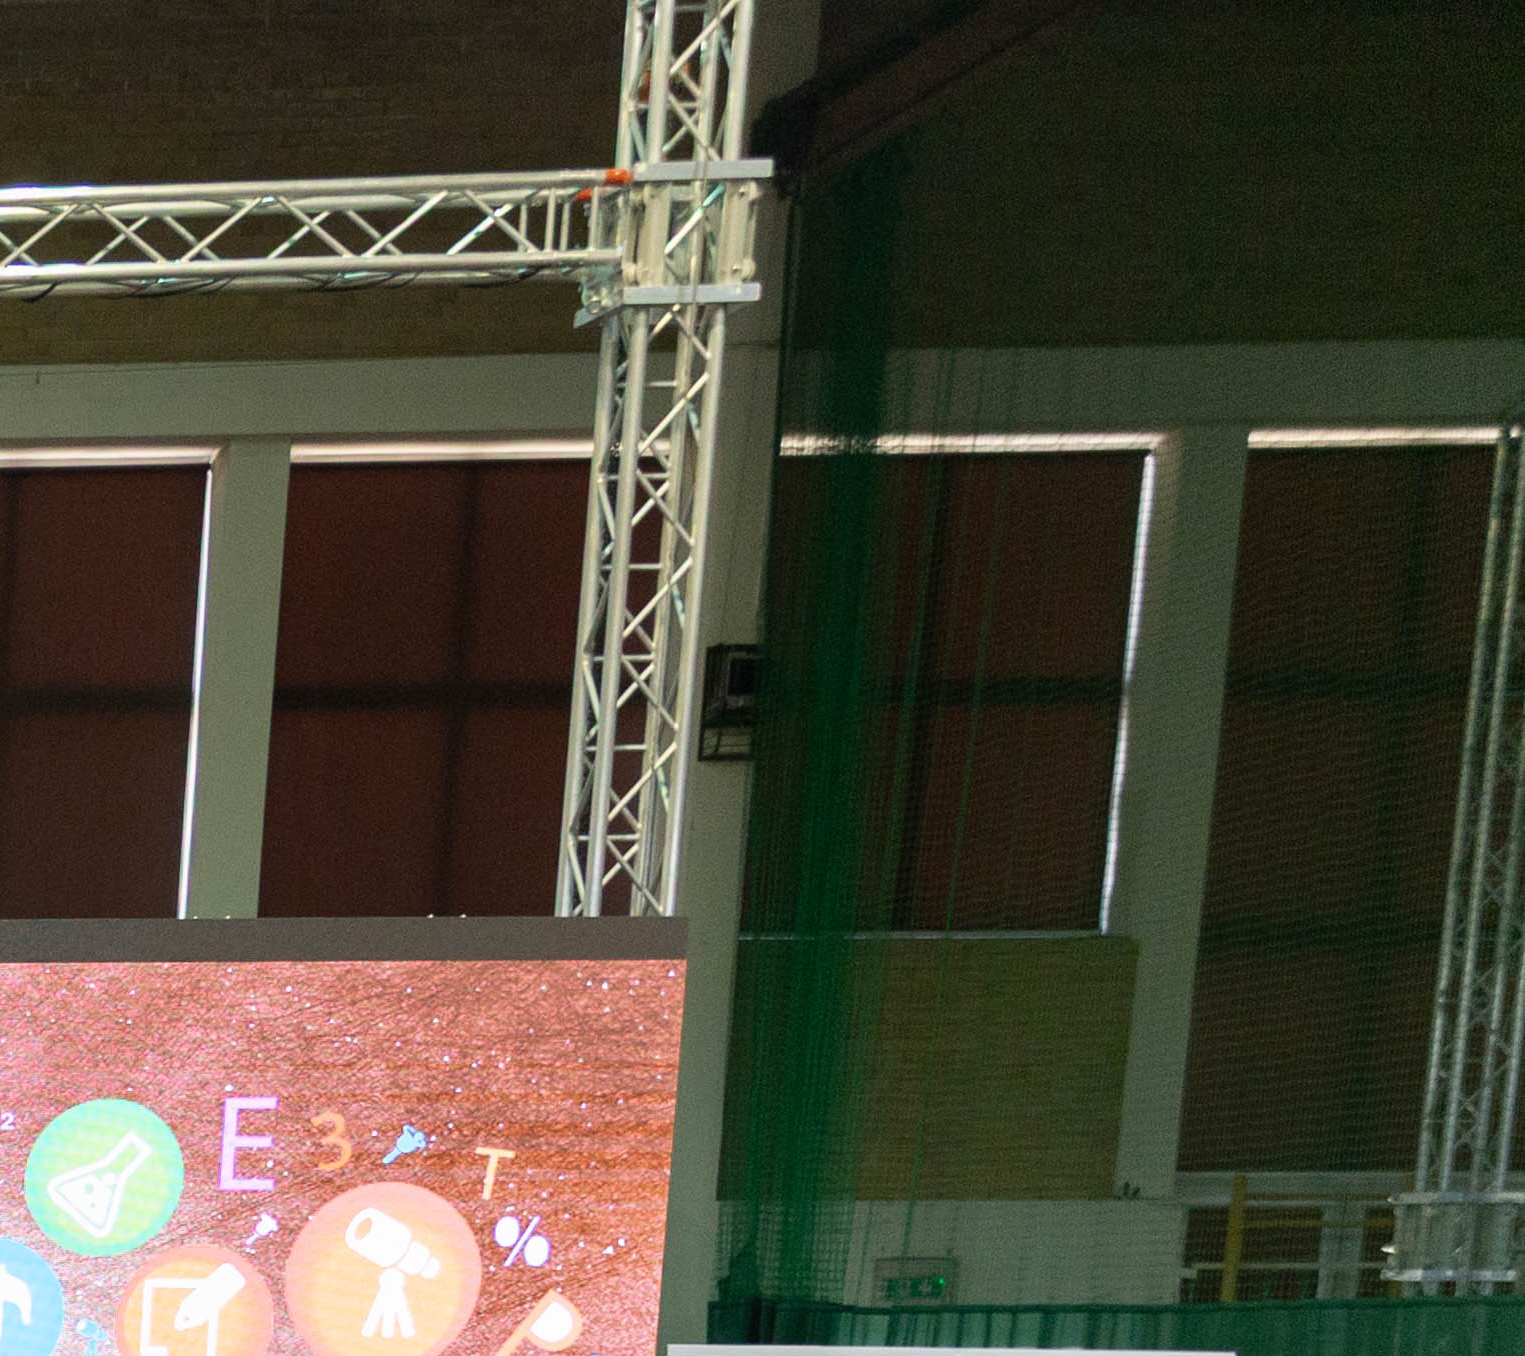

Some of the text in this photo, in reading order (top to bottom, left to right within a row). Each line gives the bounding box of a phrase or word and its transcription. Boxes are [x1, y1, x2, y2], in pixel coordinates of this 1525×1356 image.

[218, 1095, 279, 1192] E
[312, 1112, 353, 1171] 3
[475, 1146, 516, 1200] T
